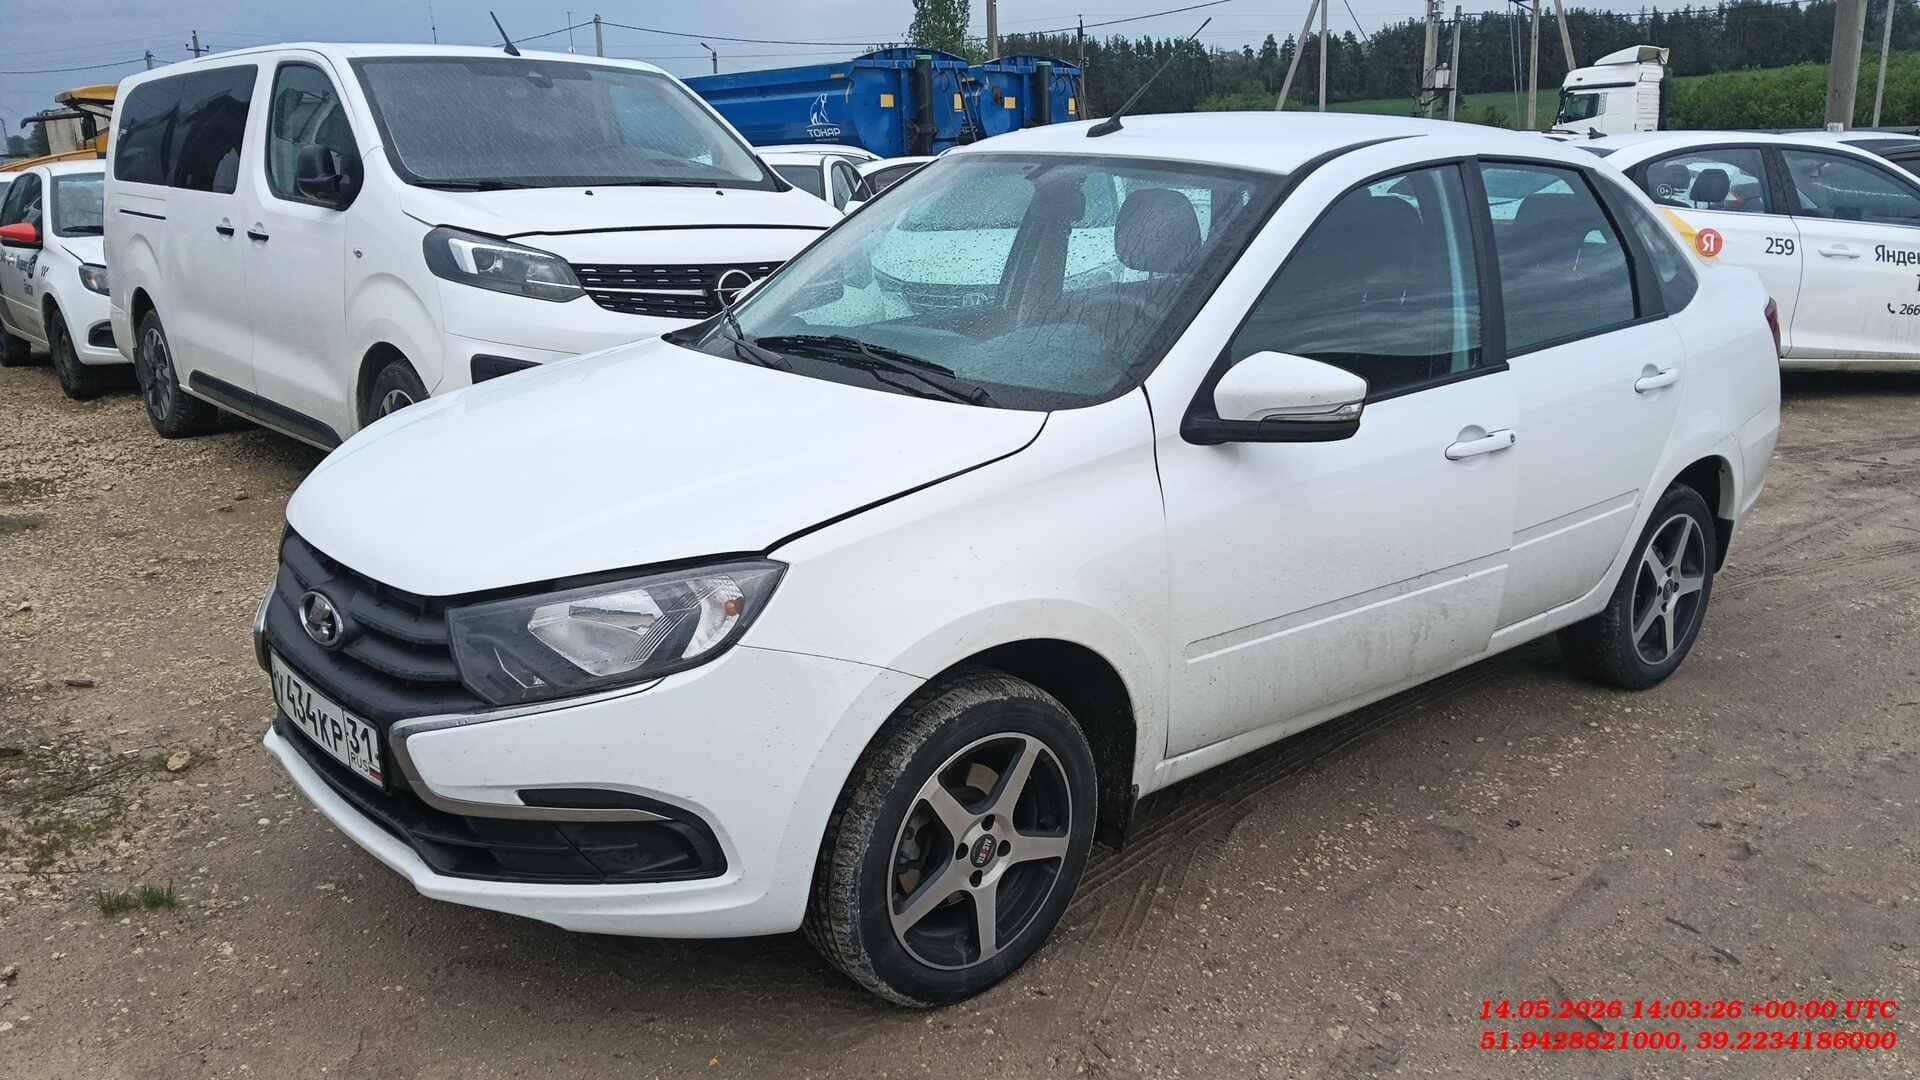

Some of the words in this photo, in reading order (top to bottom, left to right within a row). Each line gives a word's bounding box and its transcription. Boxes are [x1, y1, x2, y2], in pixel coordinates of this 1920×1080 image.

[807, 128, 841, 138] ТОНАР
[1765, 237, 1795, 256] 259
[350, 752, 369, 773] RUS
